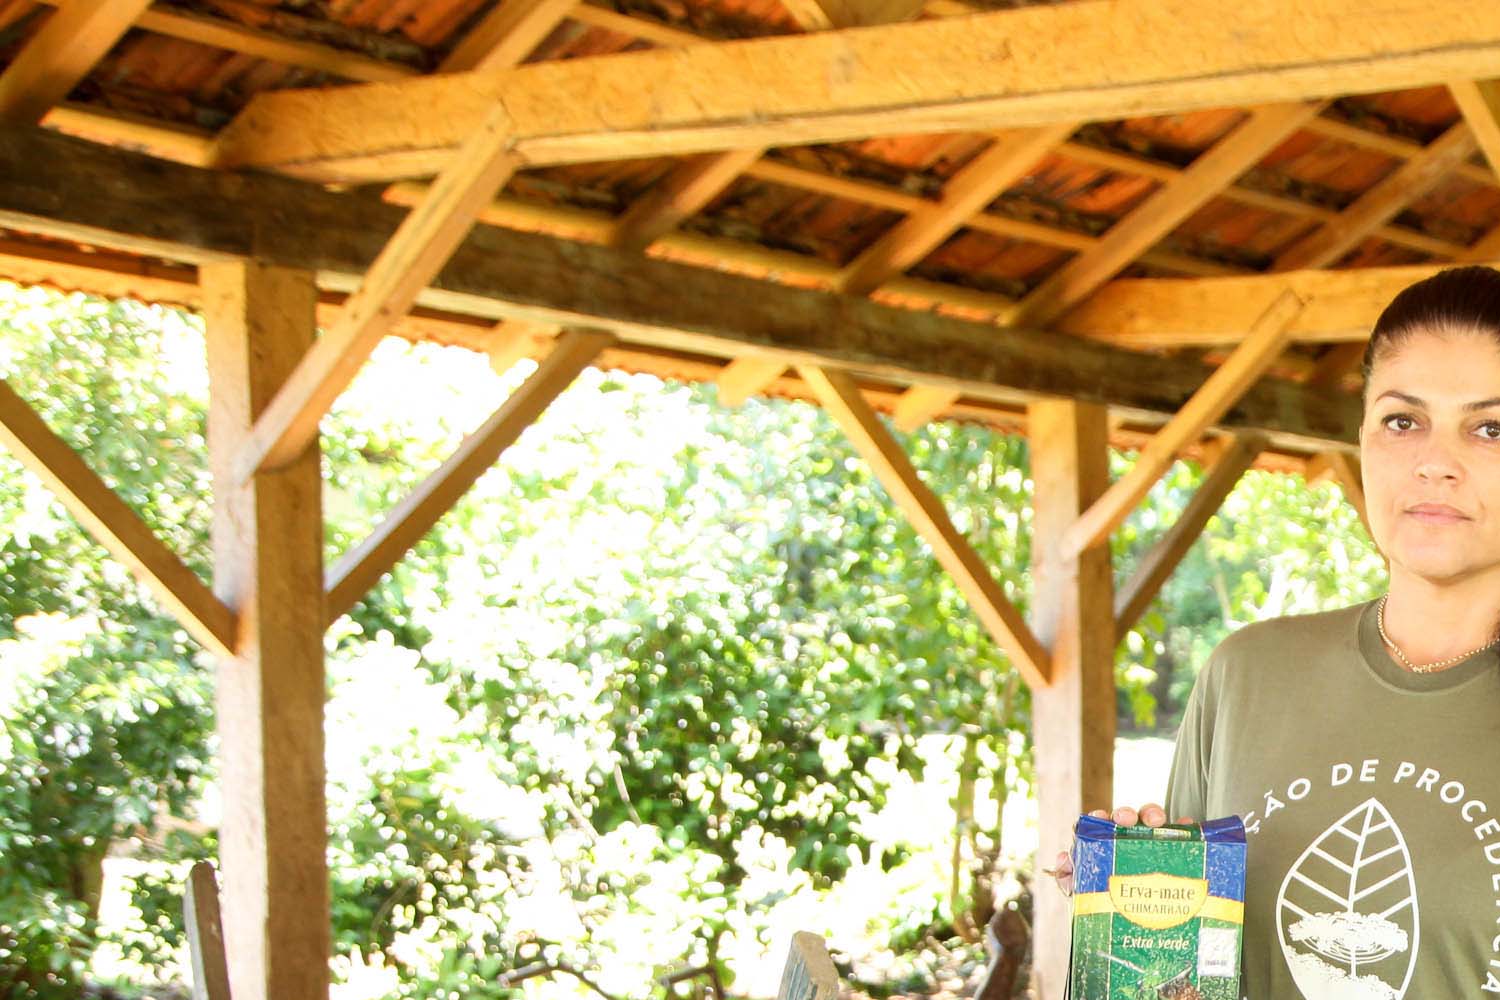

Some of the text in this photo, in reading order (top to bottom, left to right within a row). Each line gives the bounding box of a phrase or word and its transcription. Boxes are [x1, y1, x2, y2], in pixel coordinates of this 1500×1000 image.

[1331, 759, 1379, 786] DE
[1120, 883, 1195, 900] Erva-mate
[1122, 935, 1190, 951] Extra verde
